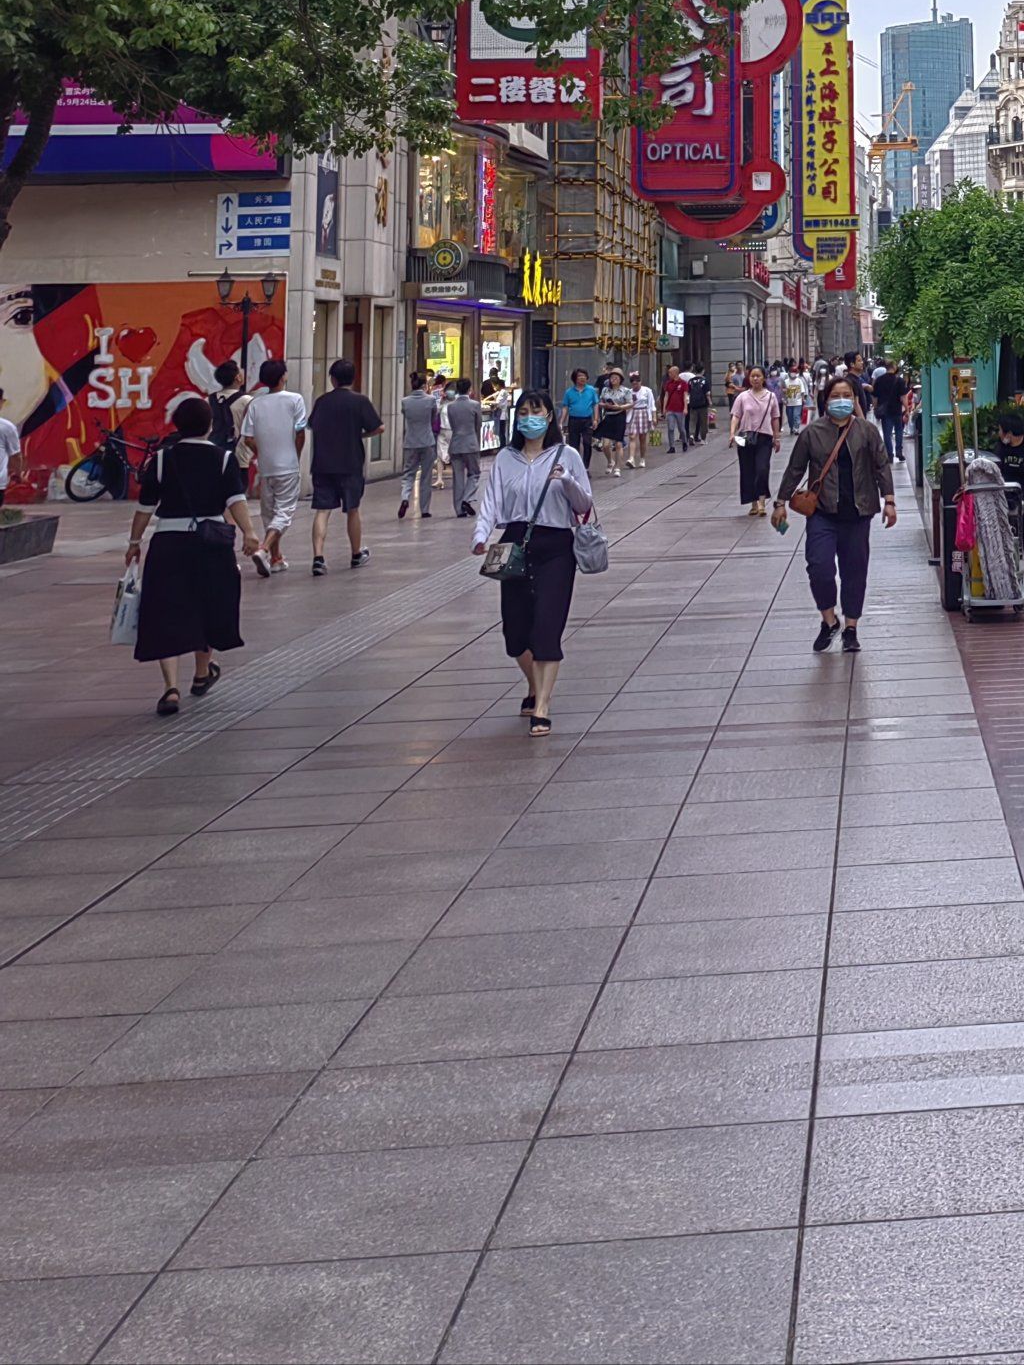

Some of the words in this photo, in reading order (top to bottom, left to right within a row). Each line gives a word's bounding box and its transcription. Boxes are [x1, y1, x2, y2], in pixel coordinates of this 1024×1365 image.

[647, 143, 726, 161] OPTICAL
[245, 216, 282, 226] 人民广场
[94, 327, 114, 365] I
[88, 366, 155, 410] SH
